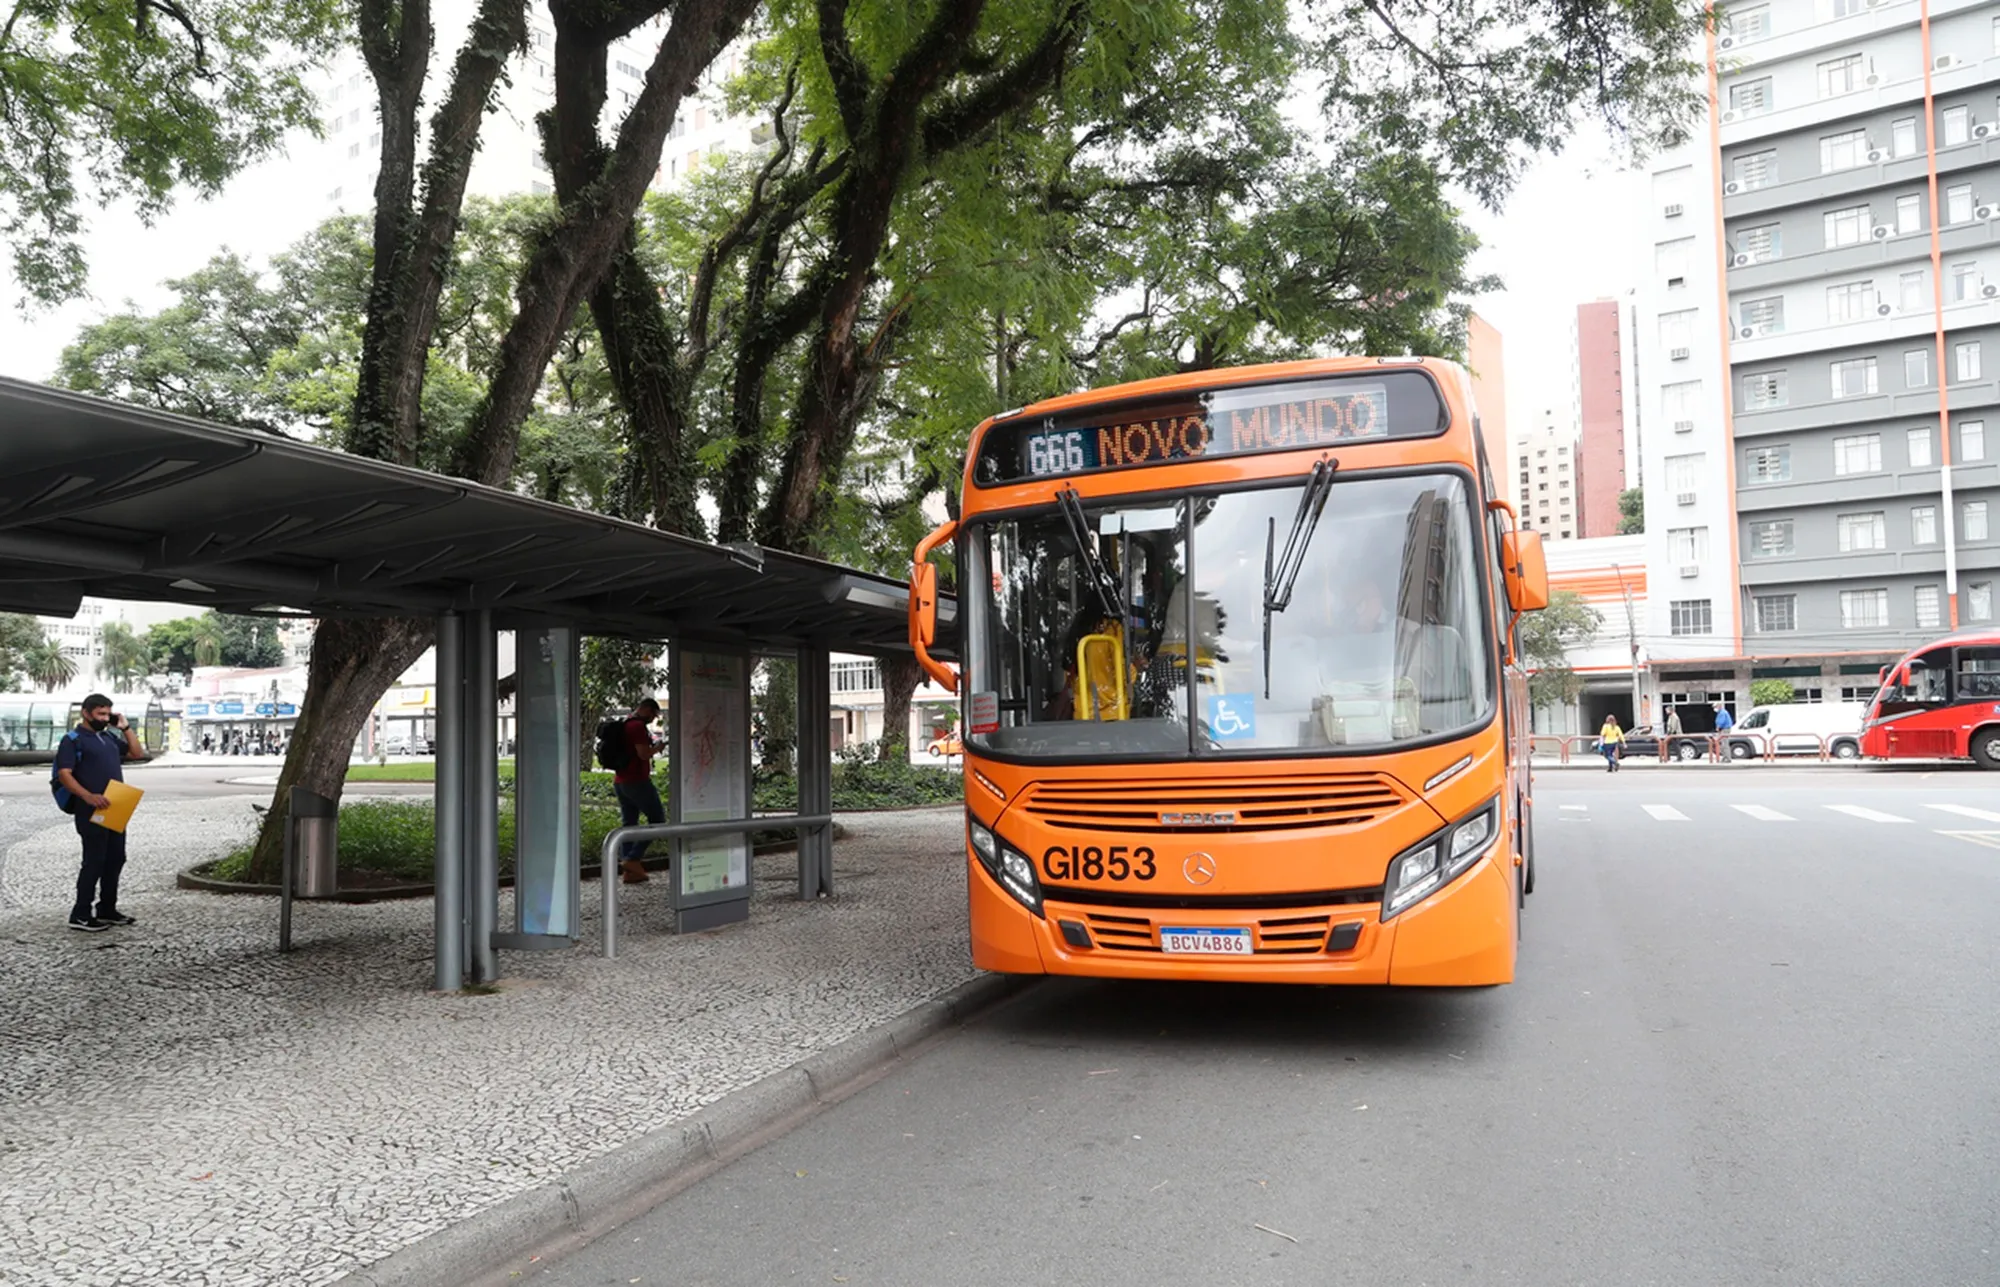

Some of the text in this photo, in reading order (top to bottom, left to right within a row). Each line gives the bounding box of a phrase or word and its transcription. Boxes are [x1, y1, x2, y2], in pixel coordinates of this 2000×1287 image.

[1029, 393, 1377, 475] 666 NOVO MUNDO
[1043, 846, 1157, 881] GI853
[1171, 936, 1243, 951] BCV4B86
